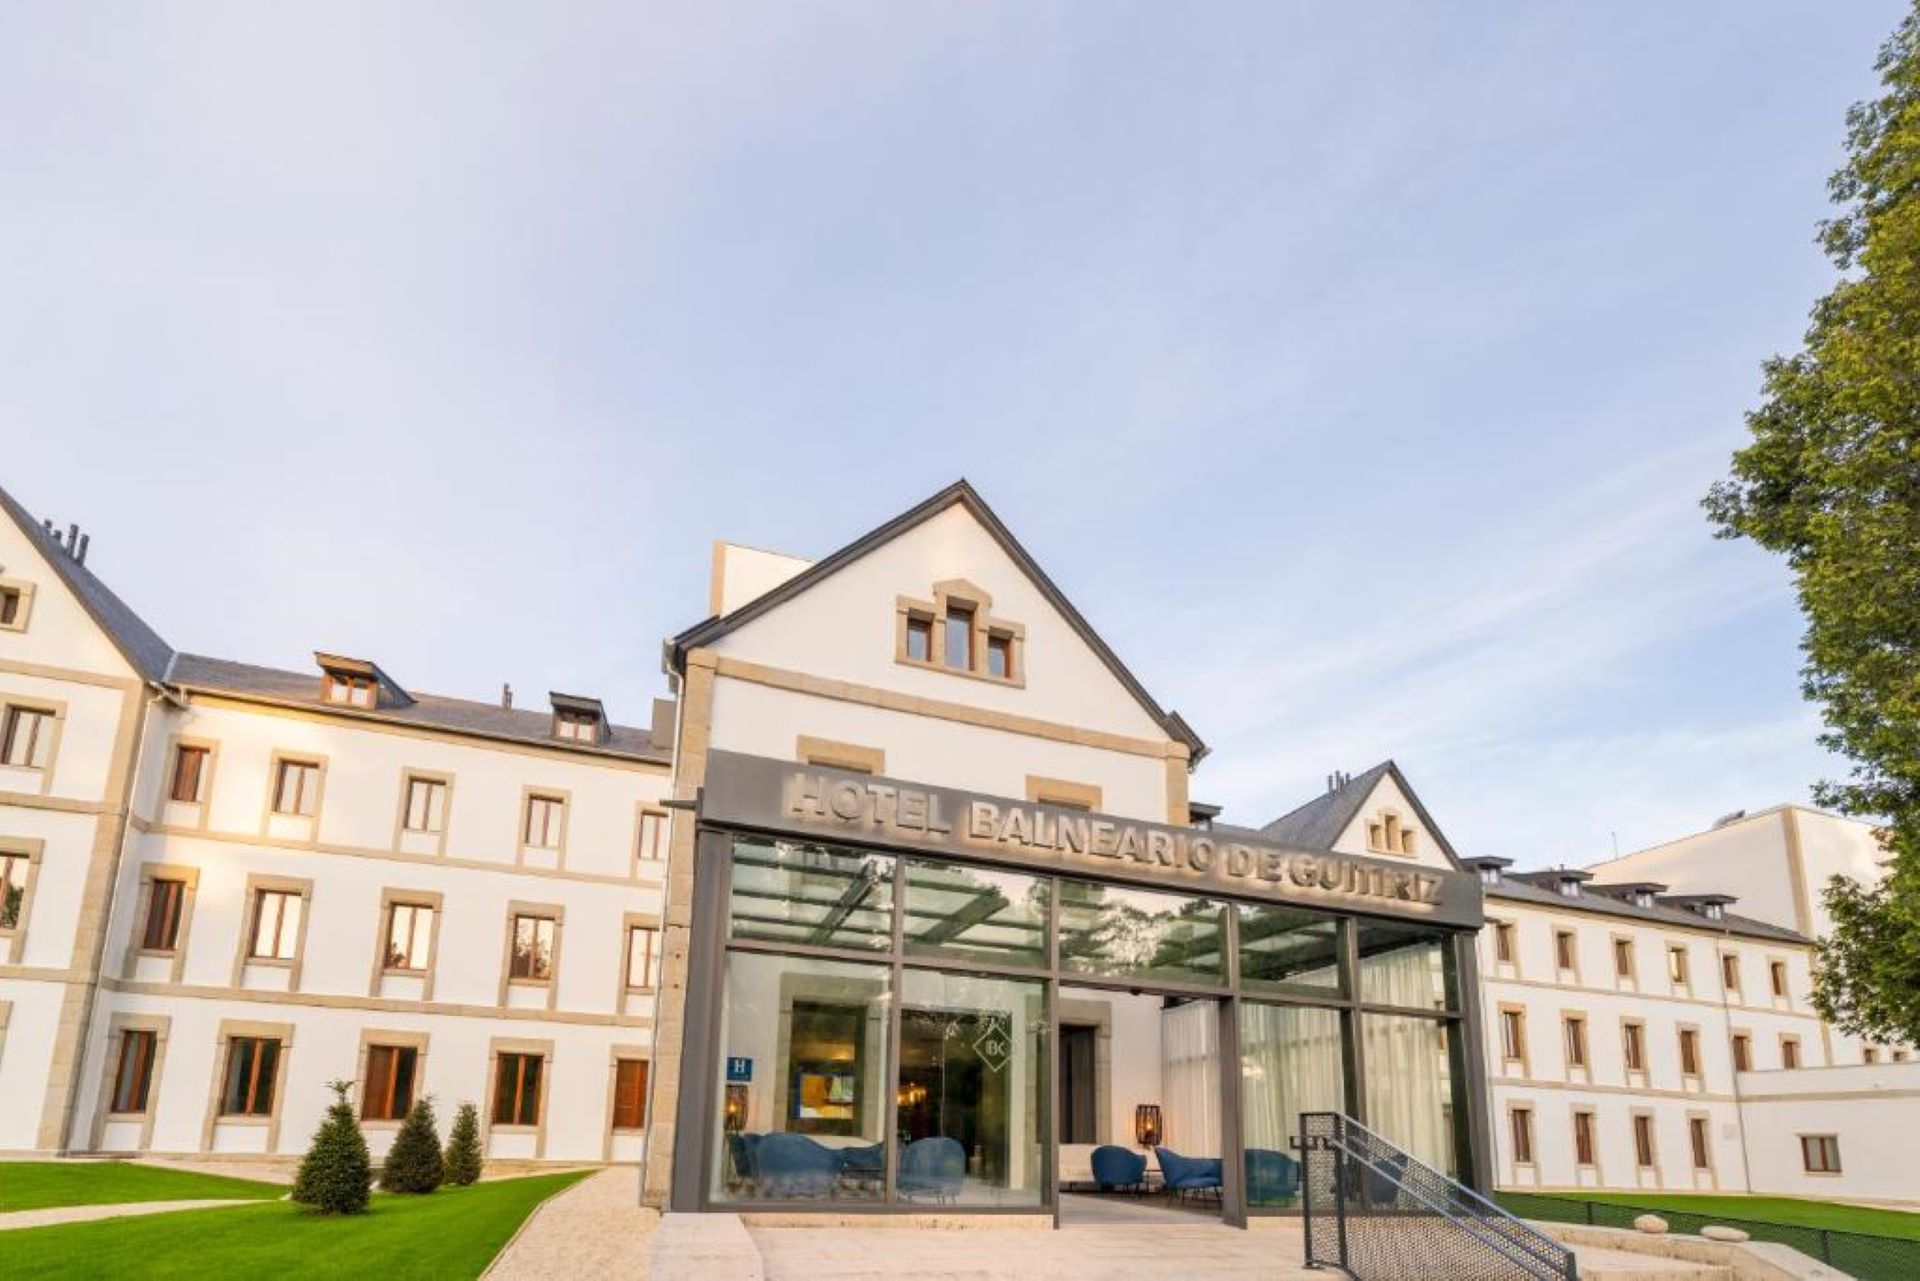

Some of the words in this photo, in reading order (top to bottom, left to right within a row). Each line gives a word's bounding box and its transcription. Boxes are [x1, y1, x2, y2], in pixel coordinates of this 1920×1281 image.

[792, 772, 951, 833] HOTEL
[969, 800, 1213, 872] BALNEARIO
[1226, 842, 1283, 881] DE
[734, 1059, 745, 1073] H
